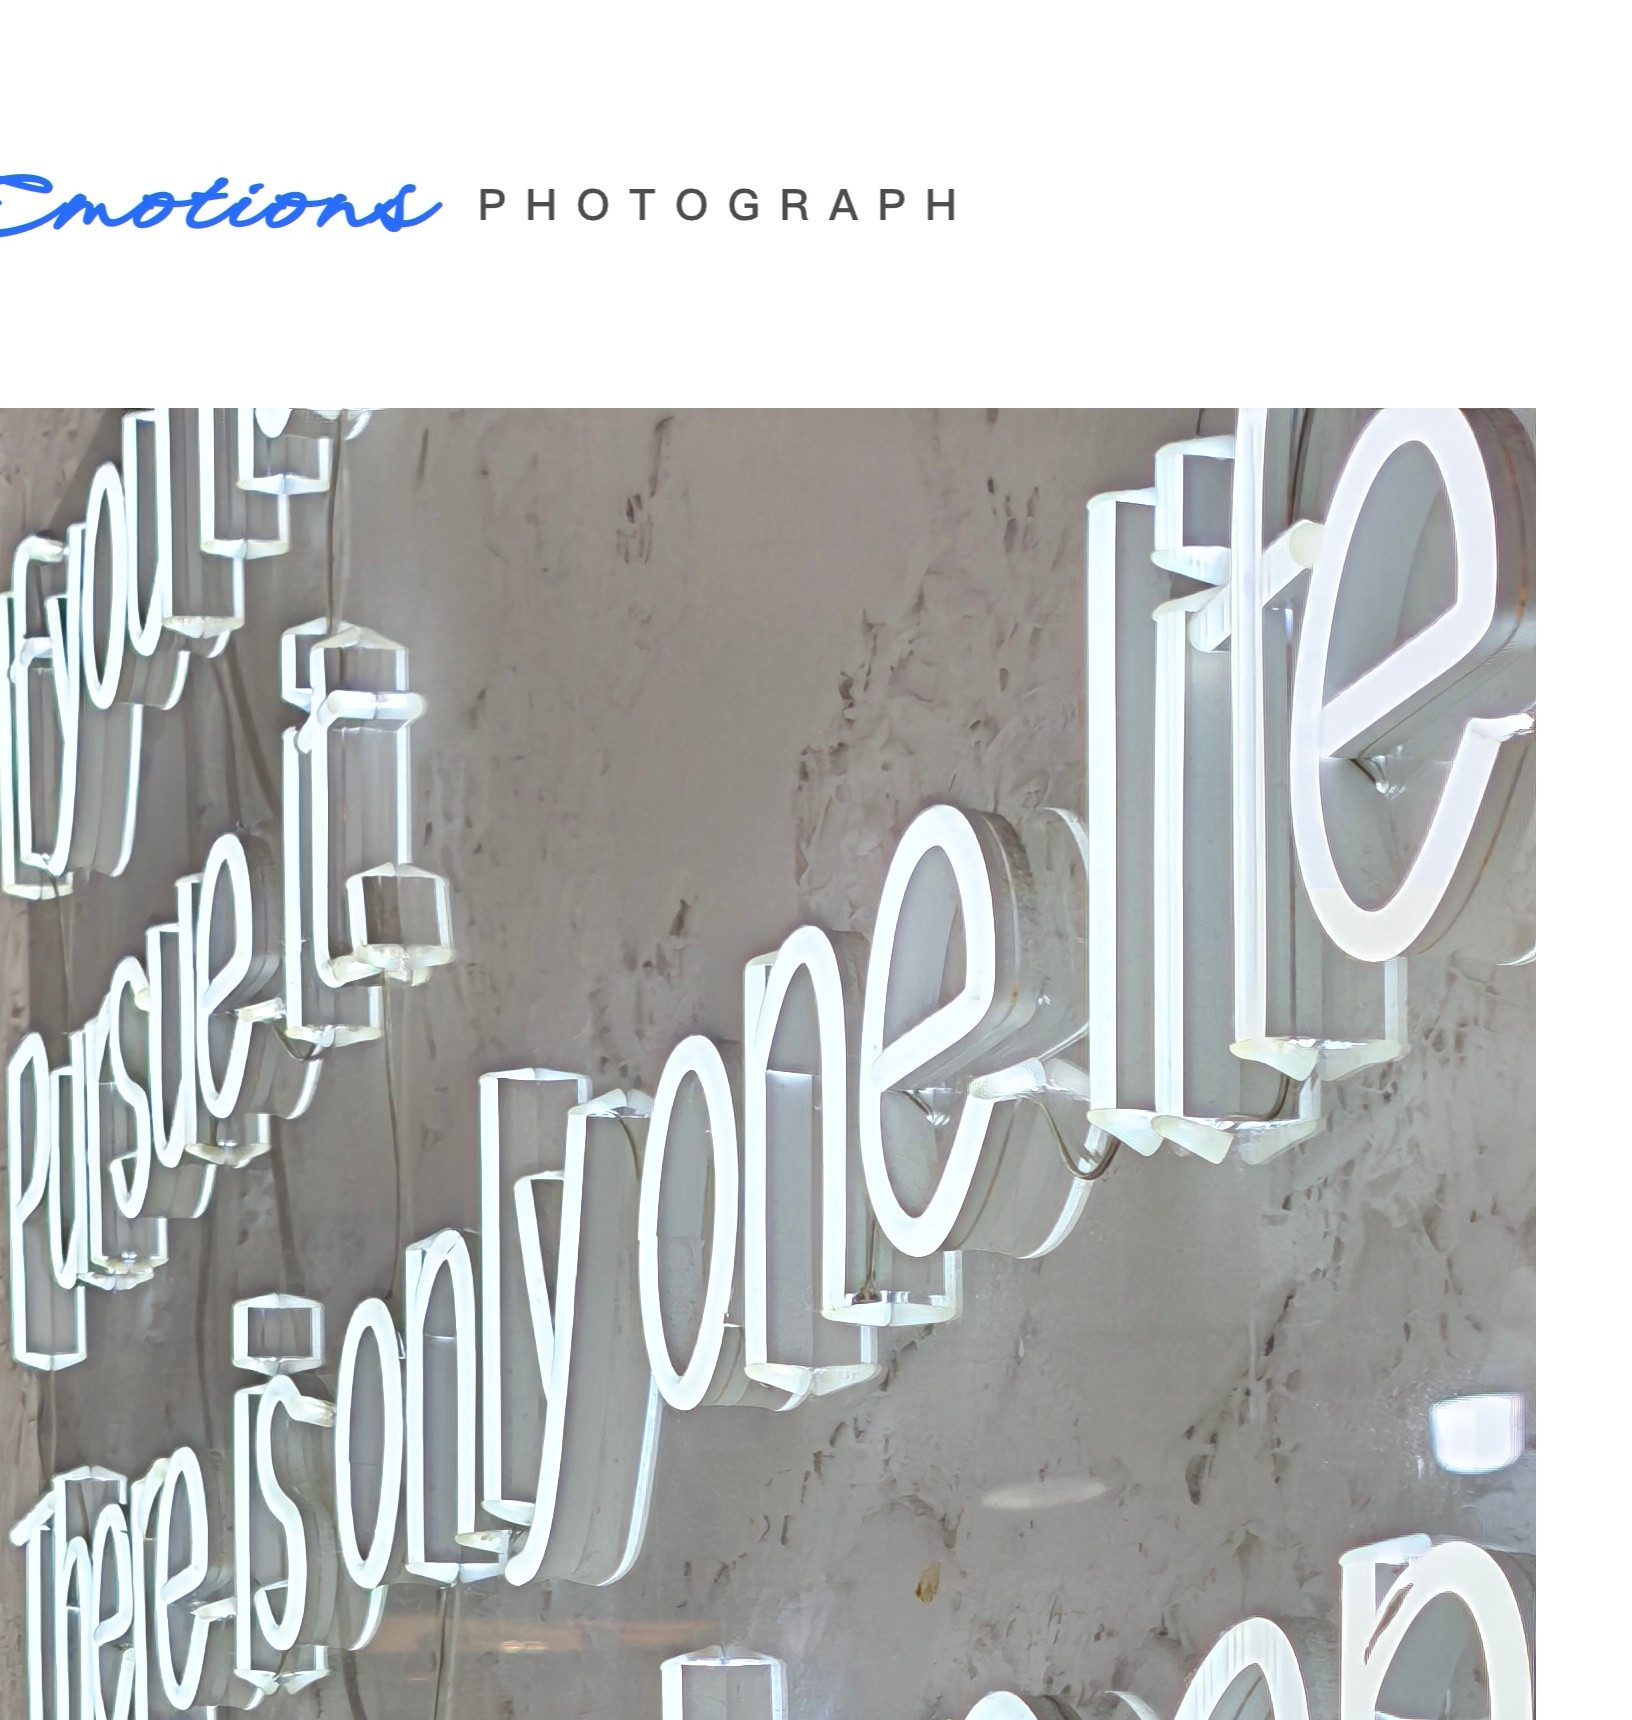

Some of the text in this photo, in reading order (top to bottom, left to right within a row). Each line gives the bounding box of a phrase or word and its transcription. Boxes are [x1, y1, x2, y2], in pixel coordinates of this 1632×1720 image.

[7, 832, 286, 1370] Pursue
[233, 1294, 336, 1694] is
[334, 1070, 592, 1588] only
[638, 803, 1048, 1411] one
